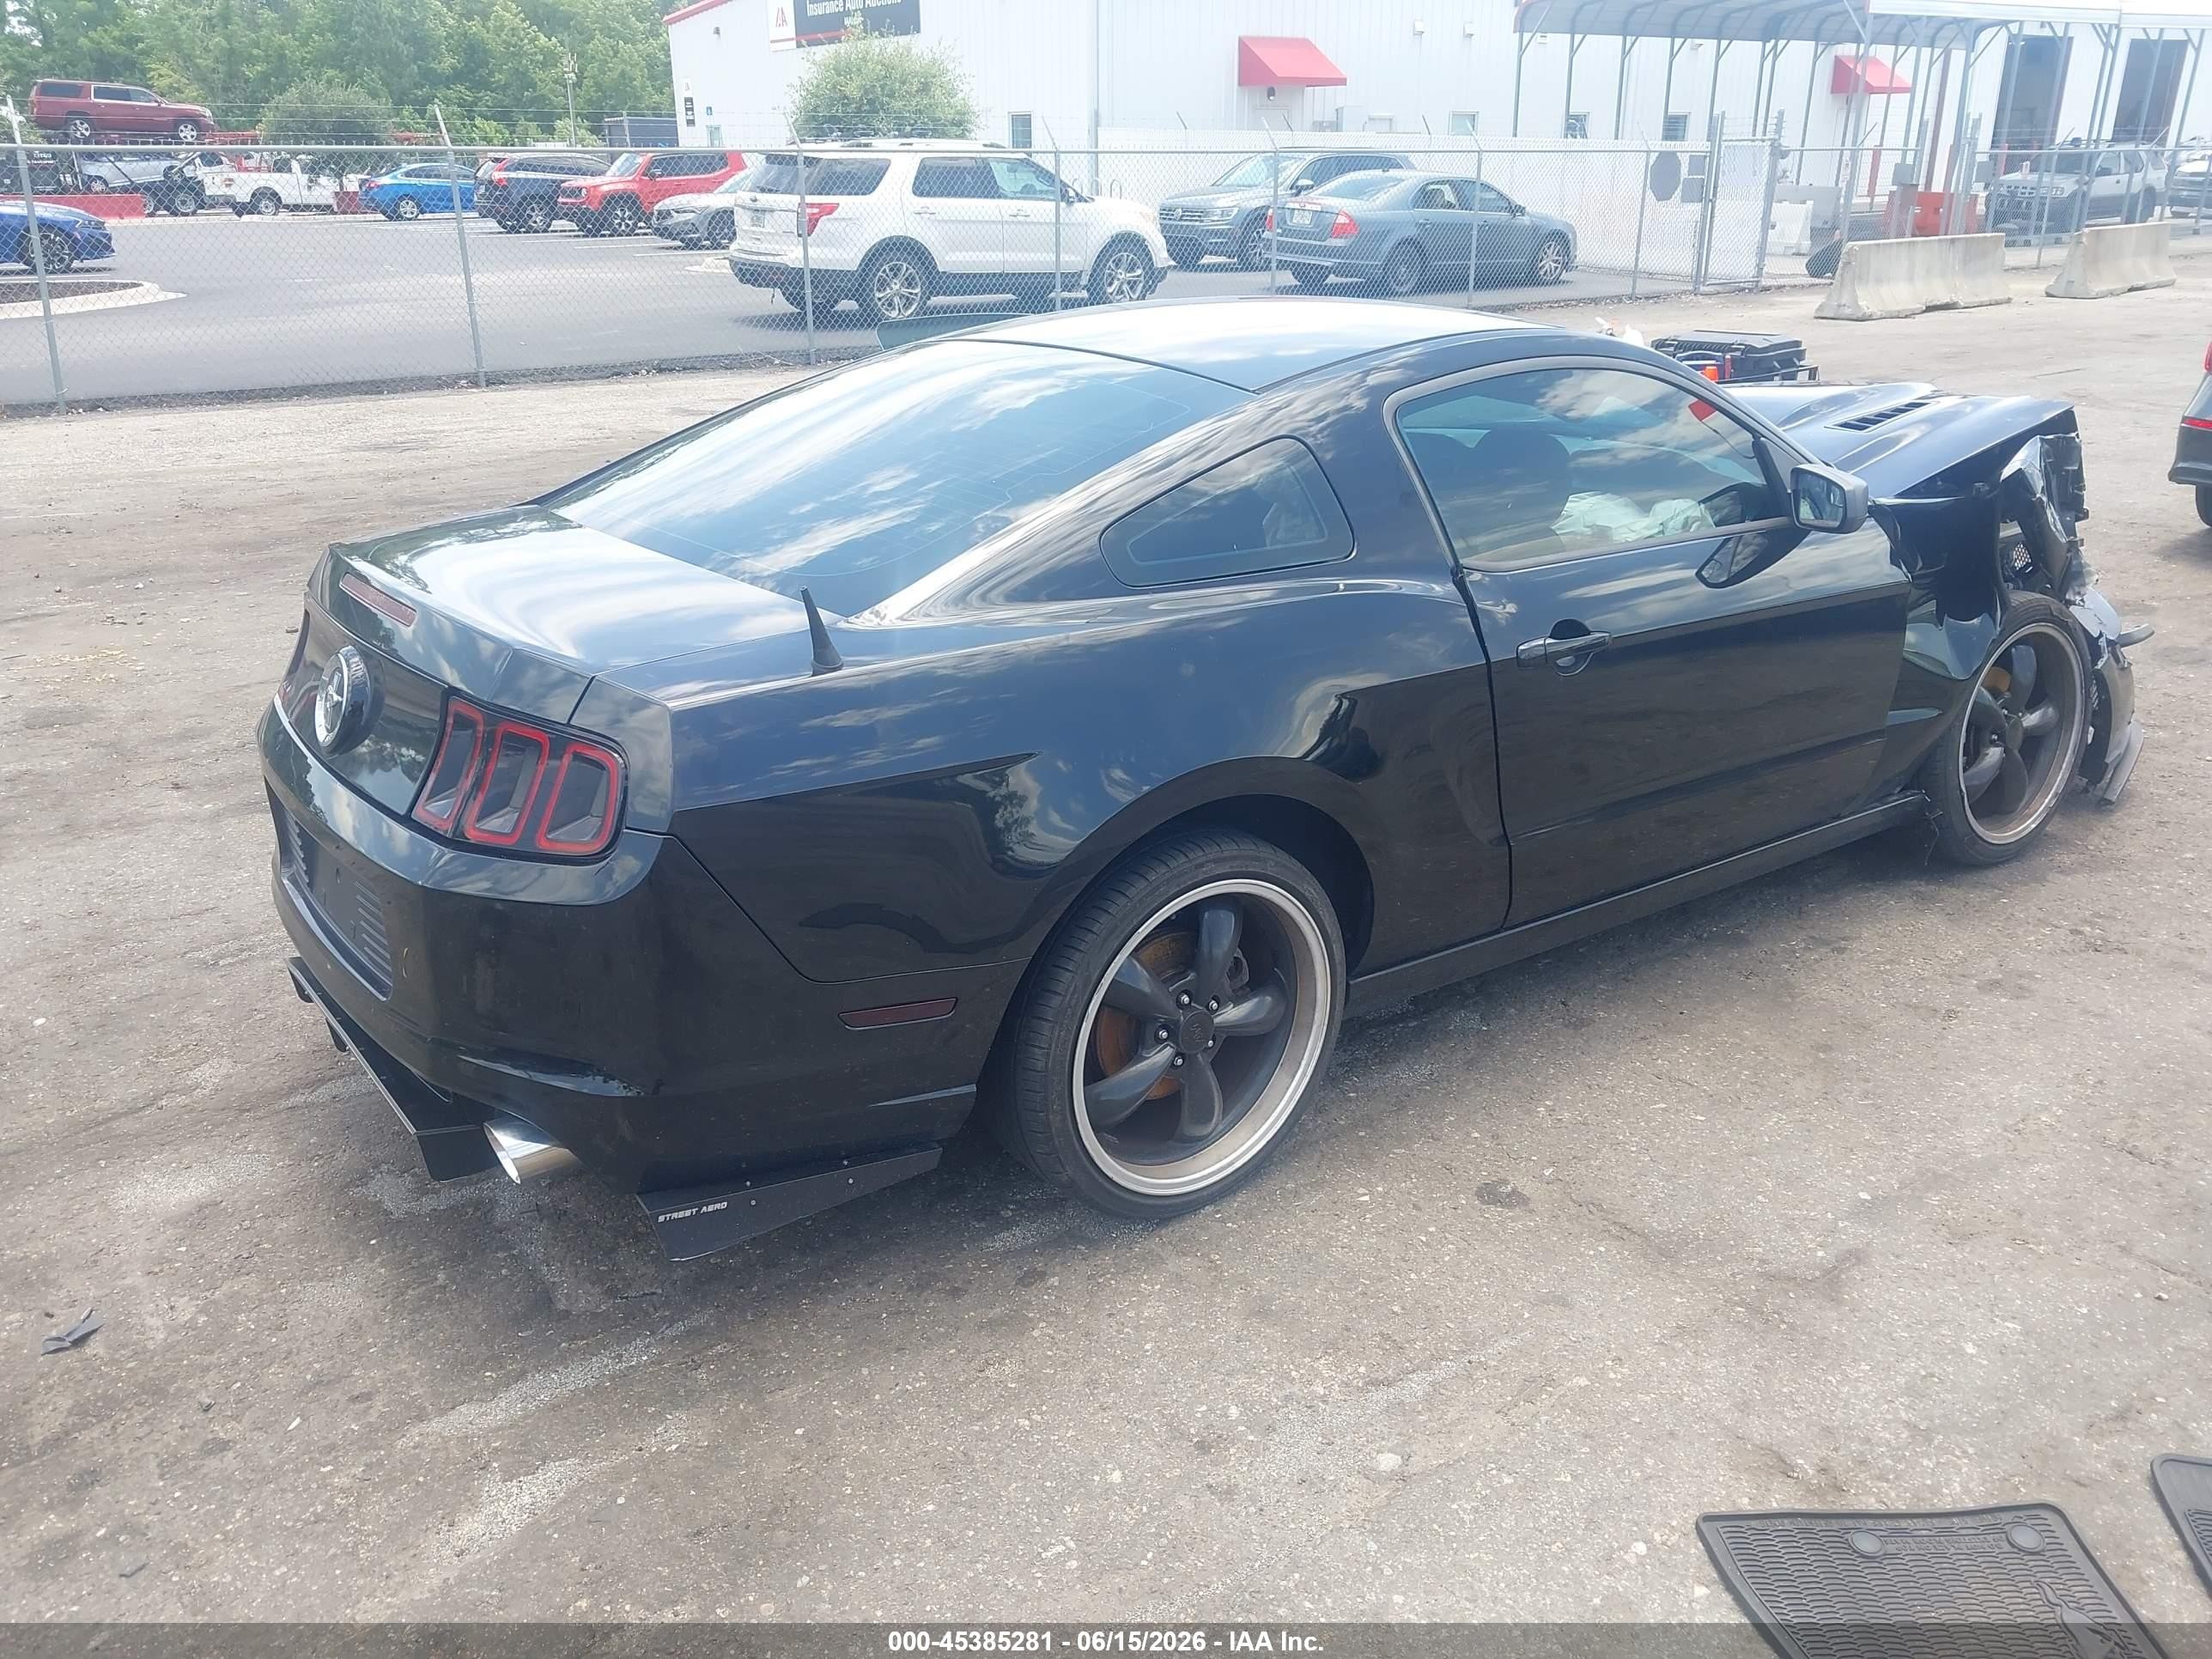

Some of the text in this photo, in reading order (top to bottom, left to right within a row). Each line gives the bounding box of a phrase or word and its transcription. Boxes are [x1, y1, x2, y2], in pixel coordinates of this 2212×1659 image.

[807, 0, 844, 16] Insurance
[845, 0, 864, 11] Auto
[658, 1201, 728, 1223] STREET AERO
